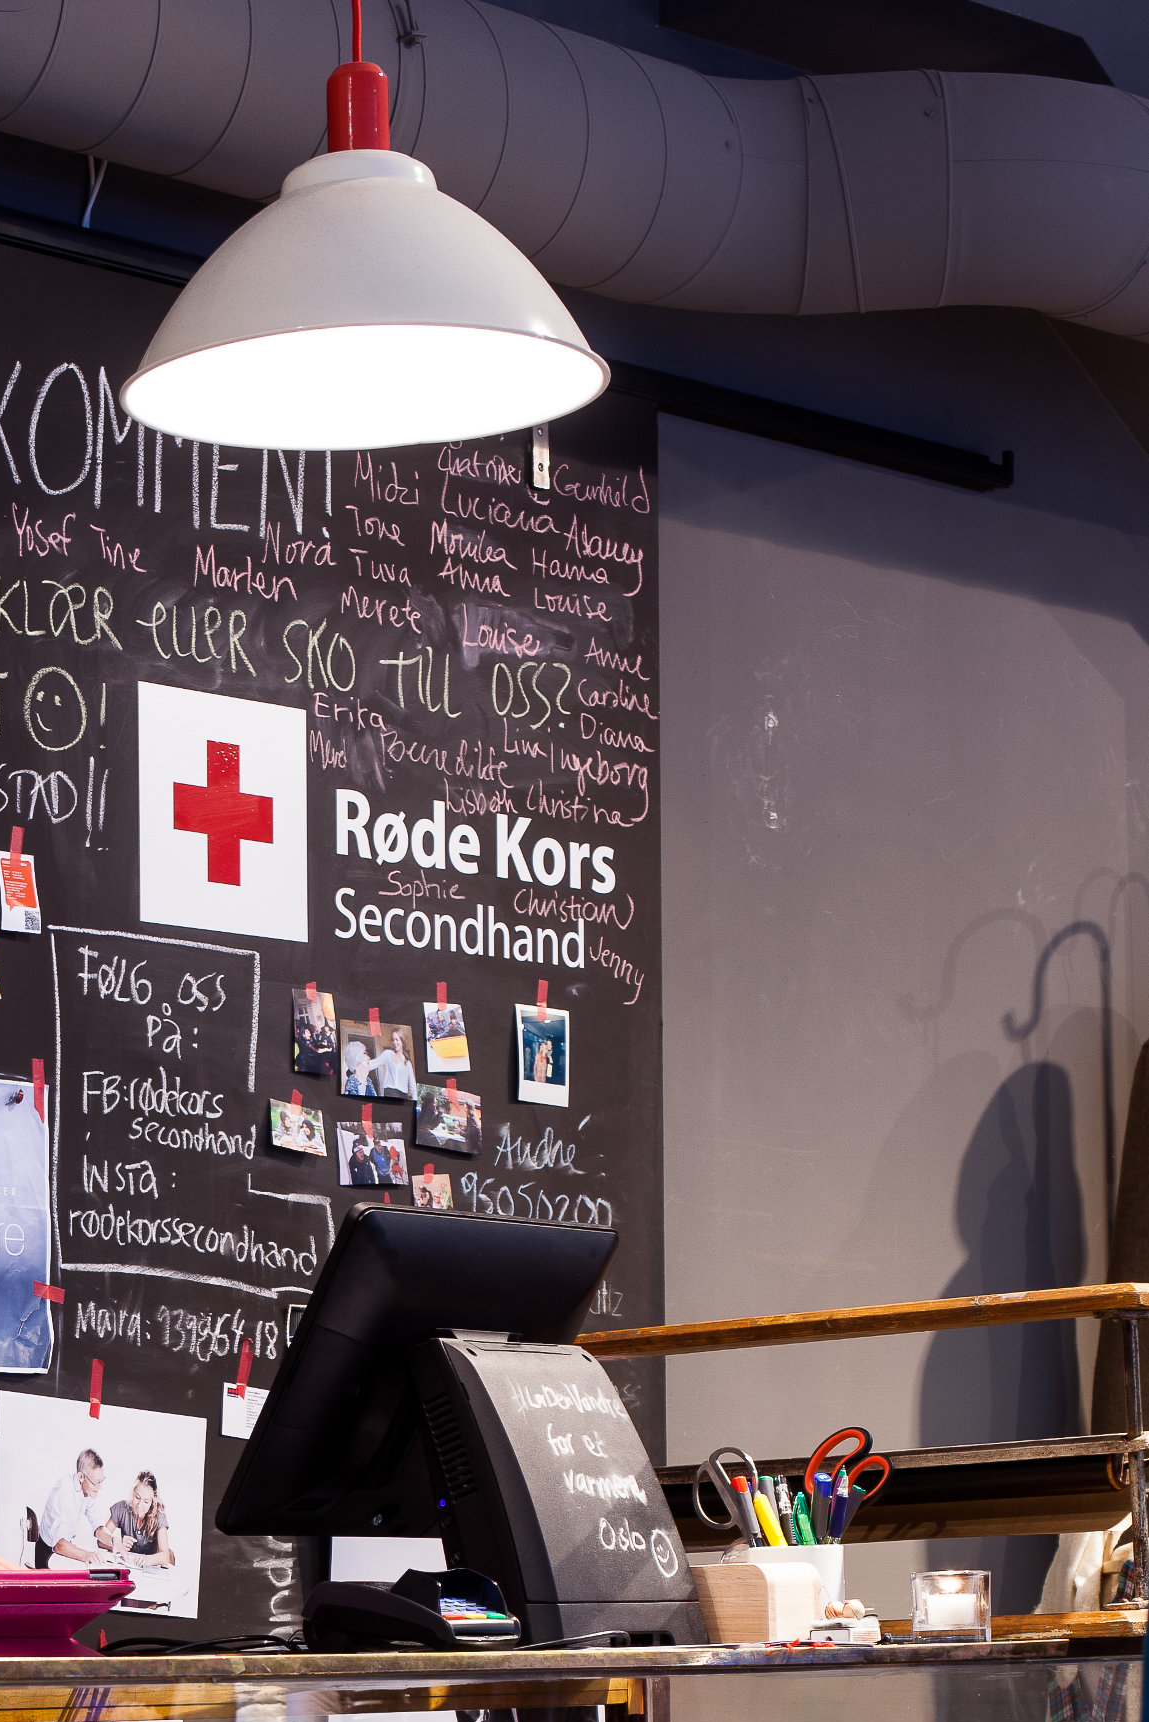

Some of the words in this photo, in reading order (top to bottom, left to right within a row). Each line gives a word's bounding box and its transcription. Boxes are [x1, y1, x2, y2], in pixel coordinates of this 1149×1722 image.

[261, 521, 338, 566] Nora
[349, 548, 413, 587] Tuva
[341, 586, 421, 634] Merete
[535, 587, 612, 622] Louise
[463, 603, 540, 659] Louise
[283, 618, 356, 691] SKO
[313, 692, 387, 732] Erika
[578, 678, 659, 720] Caroline
[580, 712, 656, 753] Diana
[336, 788, 482, 876] Røde
[495, 812, 617, 894] Kors
[378, 869, 466, 909] Sophie
[334, 887, 585, 969] Secondhand
[589, 936, 644, 1005] Jenny
[128, 1117, 256, 1160] secondhand
[598, 1517, 647, 1551] Oslo
